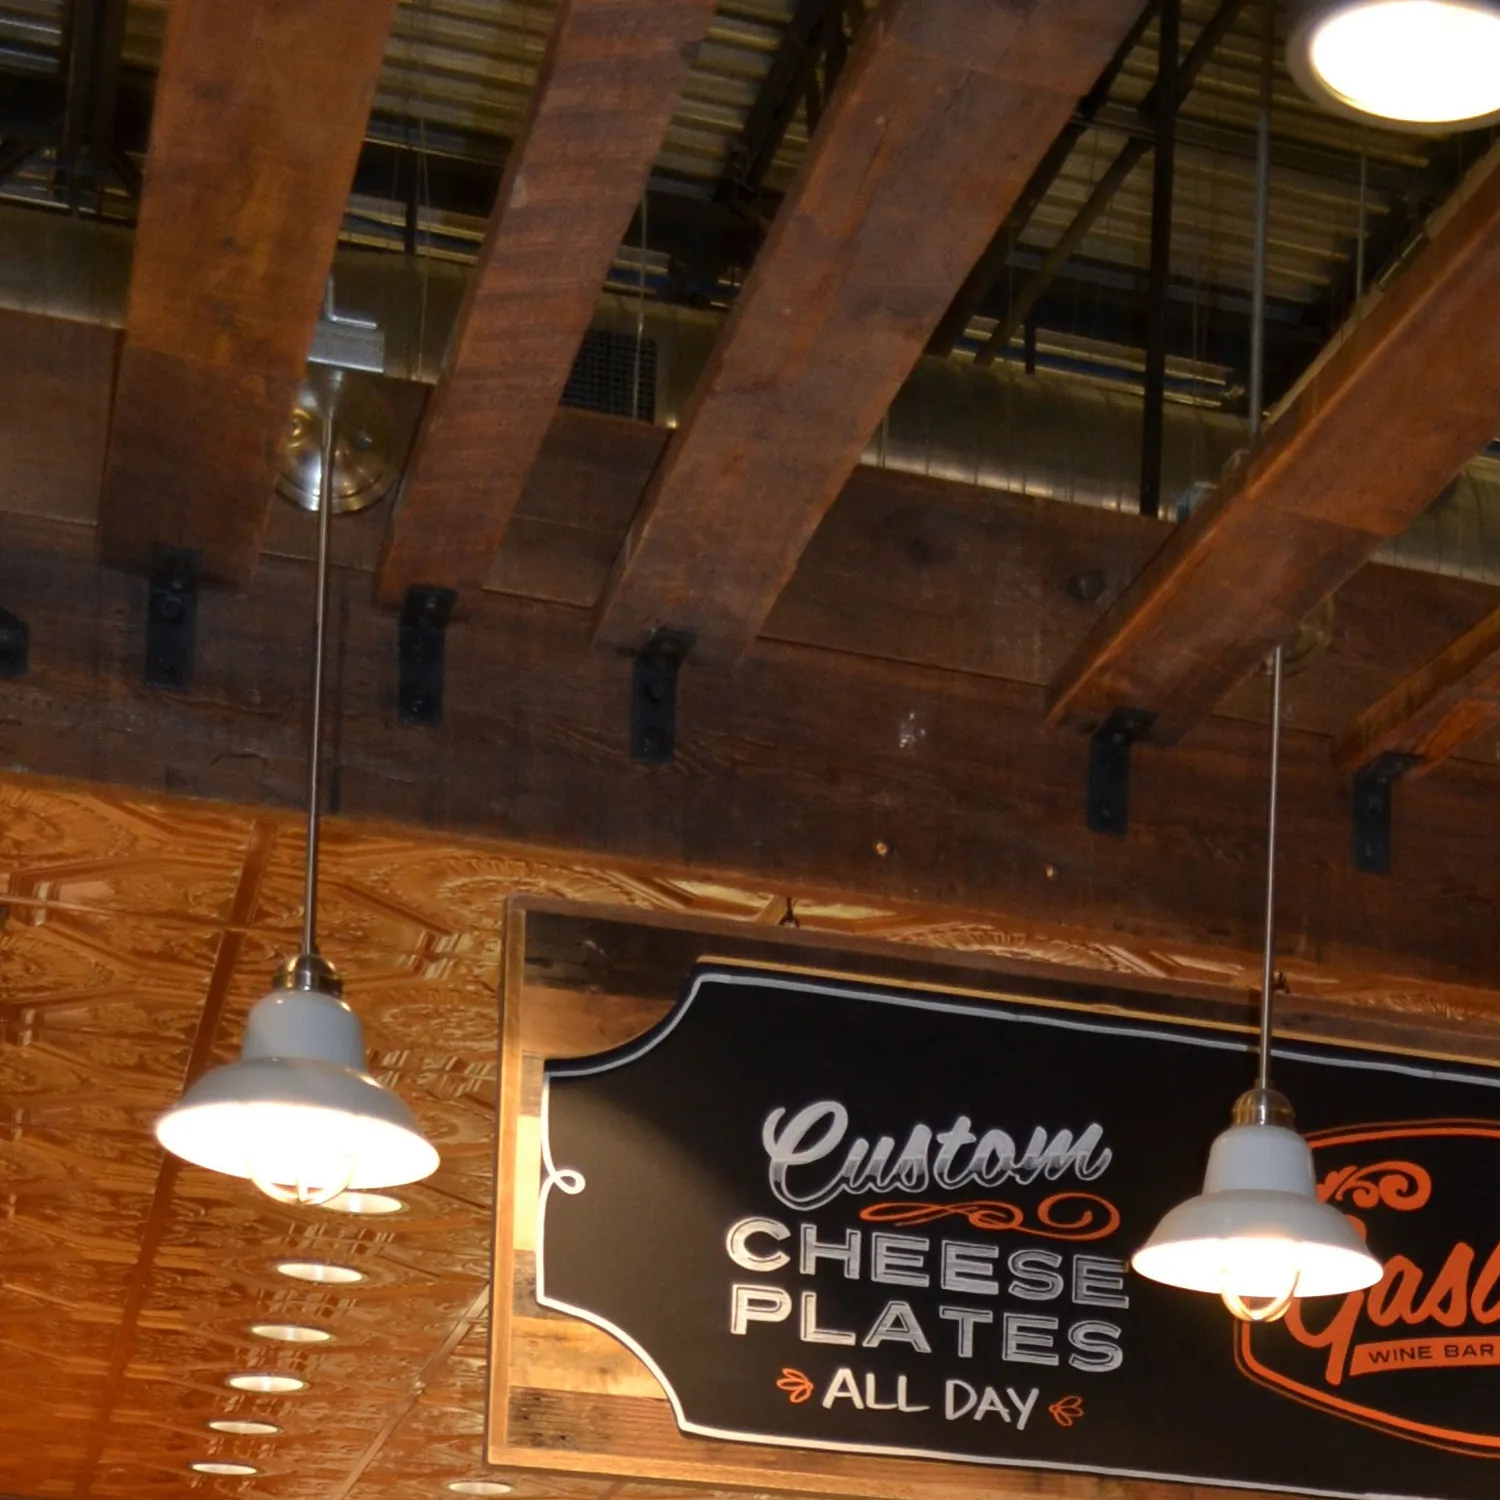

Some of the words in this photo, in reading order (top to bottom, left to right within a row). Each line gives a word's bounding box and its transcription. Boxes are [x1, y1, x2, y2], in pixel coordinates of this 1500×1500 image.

[761, 1100, 1113, 1211] Custom
[725, 1215, 1130, 1310] CHEESE
[729, 1283, 1124, 1373] PLATES
[1368, 1343, 1433, 1364] WINE
[1444, 1341, 1496, 1360] BAR
[823, 1367, 930, 1414] ALL
[945, 1380, 1040, 1431] DAY
